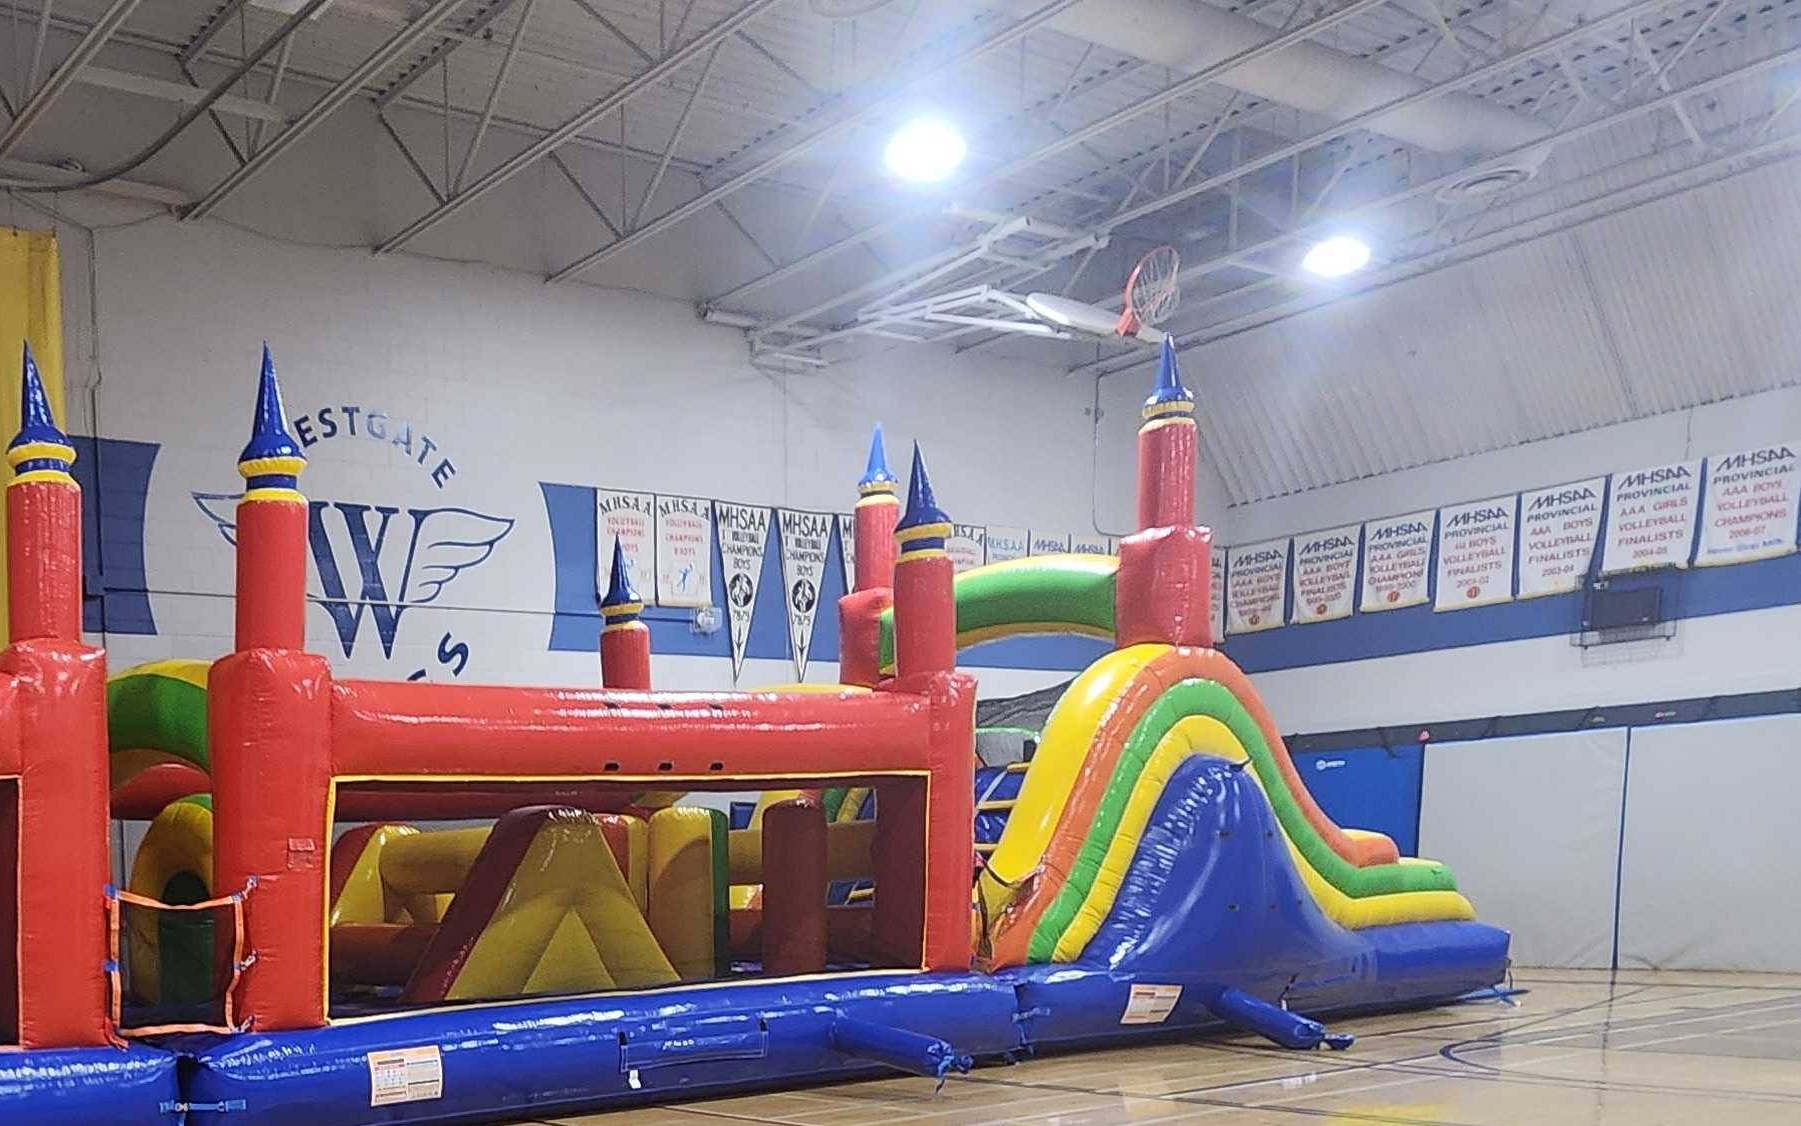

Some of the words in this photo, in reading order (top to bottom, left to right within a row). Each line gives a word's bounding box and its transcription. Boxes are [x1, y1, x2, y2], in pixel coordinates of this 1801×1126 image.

[294, 406, 457, 489] ESTGATE
[1715, 446, 1797, 472] MHSAA
[1618, 465, 1691, 490] MHSAA
[1713, 464, 1796, 485] PROVINCIAL
[1528, 487, 1596, 512] MHSAA
[1616, 481, 1691, 502] PROVINCIAL
[1722, 485, 1748, 496] AAA
[1620, 505, 1646, 518] AAA
[1653, 496, 1688, 511] GIRLS
[1717, 493, 1790, 512] VOLLEYBALL
[718, 505, 766, 532] MHSAA
[1446, 506, 1509, 528] MHSAA
[1527, 503, 1597, 523] PROVINCIAL
[1619, 513, 1686, 533] VOLLEYBALL
[1714, 507, 1788, 528] CHAMPIONS
[782, 512, 828, 538] MHSAA
[1370, 521, 1428, 541] MHSAA
[1445, 522, 1509, 540] PROVINCIAL
[1563, 517, 1593, 531] BOYS
[1300, 536, 1355, 555] MHSAA
[1369, 535, 1428, 552] PROVINCIAL
[1528, 533, 1593, 551] VOLLEYBALL
[1617, 529, 1684, 547] FINALISTS
[1528, 547, 1590, 564] FINALISTS
[1448, 559, 1502, 576] FINALISTS
